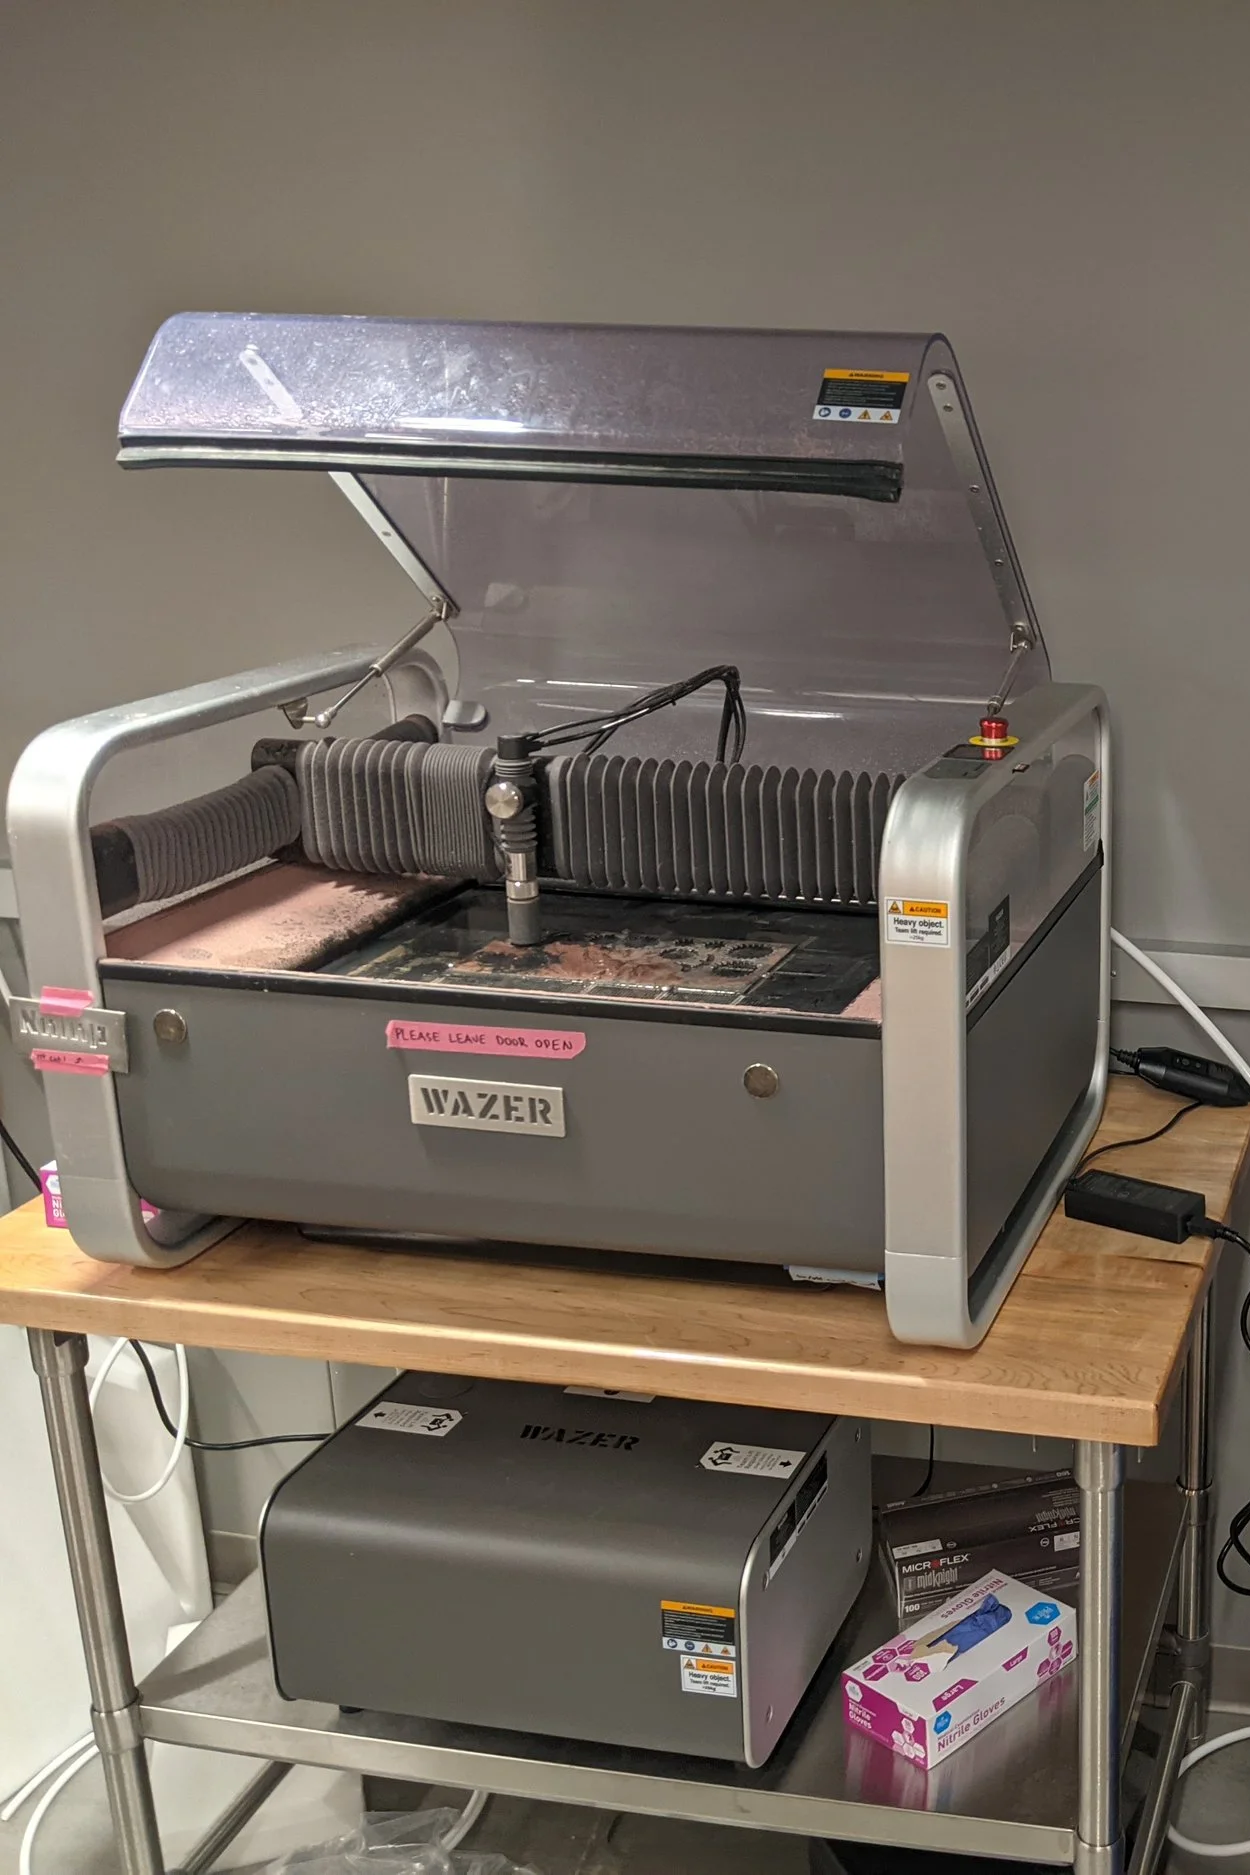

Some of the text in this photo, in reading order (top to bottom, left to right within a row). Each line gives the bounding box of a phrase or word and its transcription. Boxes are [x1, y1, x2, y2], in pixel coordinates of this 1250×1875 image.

[893, 917, 944, 929] Heavy object.
[394, 1027, 573, 1051] PLEASE LEAVE DOOR OPEN
[420, 1087, 552, 1125] WAZER
[520, 1424, 640, 1451] WAZER
[972, 1578, 1004, 1598] Nitrile
[904, 1603, 920, 1613] 100
[941, 1597, 974, 1619] Gloves
[689, 1671, 731, 1682] Heavy object.
[941, 1684, 964, 1701] Large
[848, 1702, 871, 1721] Nitrile
[848, 1710, 872, 1729] Gloves
[937, 1723, 971, 1752] Nitrile
[973, 1696, 1006, 1726] Gloves
